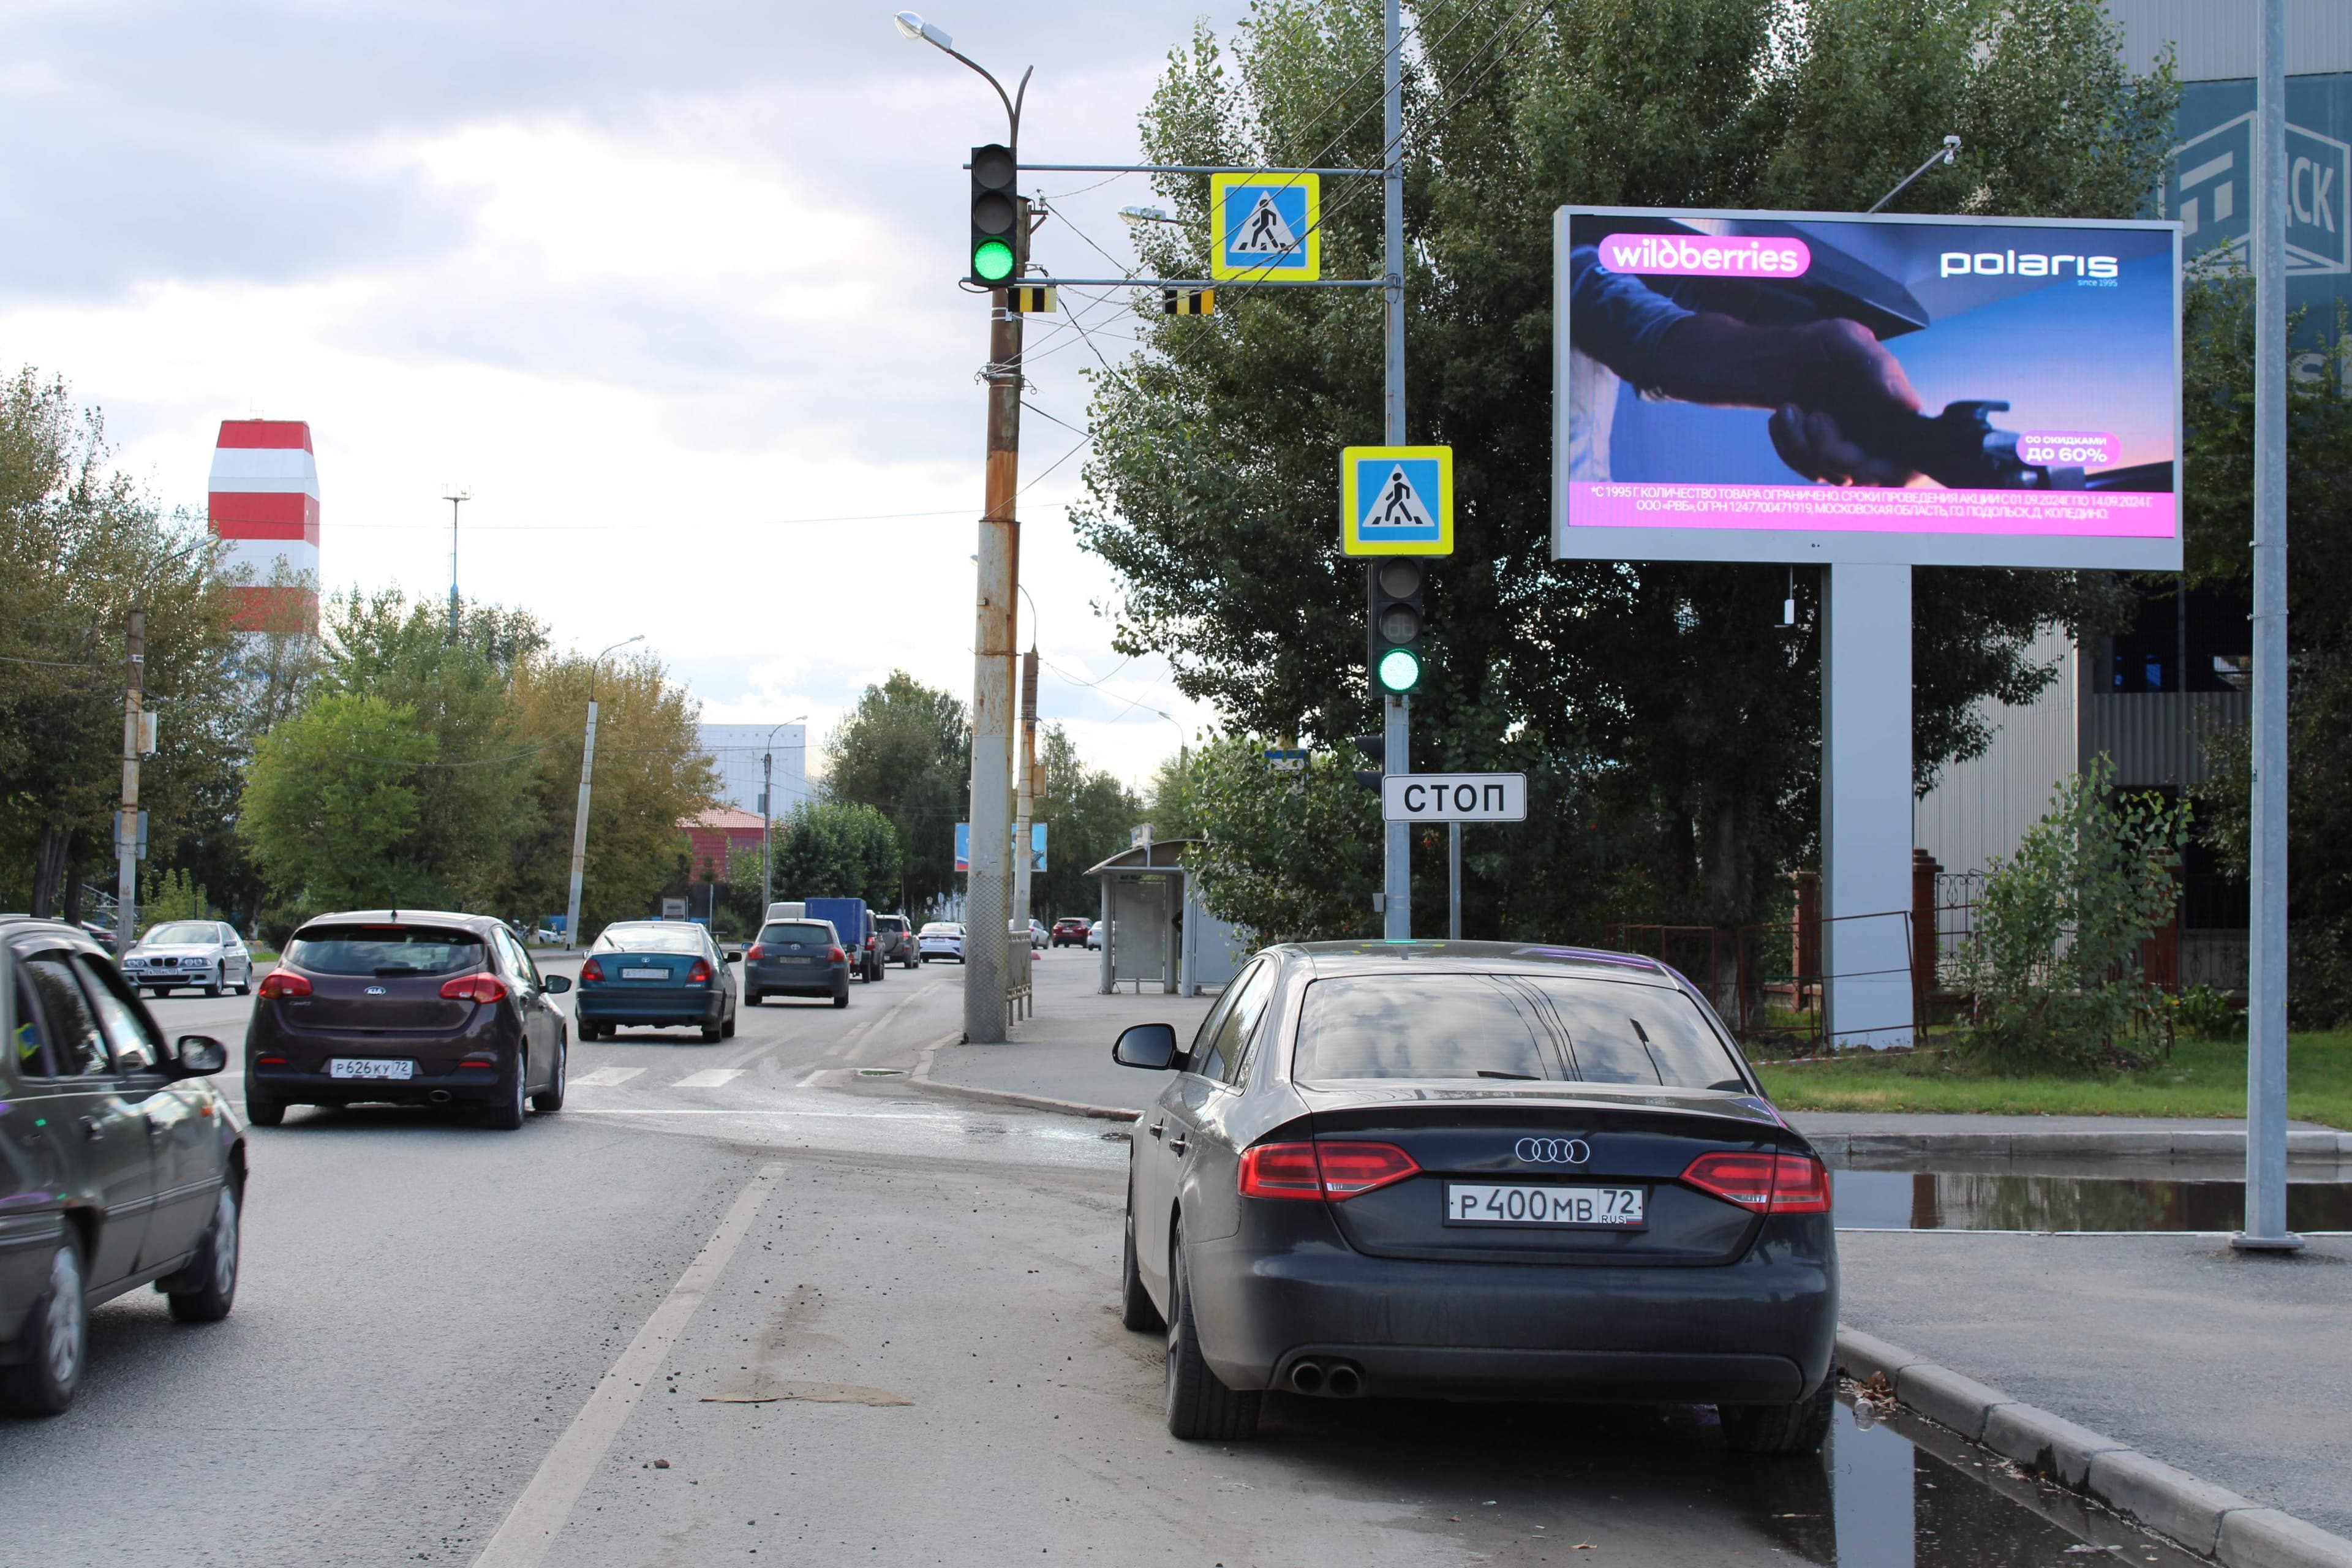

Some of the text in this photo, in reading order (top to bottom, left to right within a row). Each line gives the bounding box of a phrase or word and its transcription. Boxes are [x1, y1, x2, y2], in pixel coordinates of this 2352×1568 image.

[2285, 152, 2335, 233] СК
[1612, 238, 1798, 272] wildberries
[1940, 249, 2118, 278] polaris
[2099, 279, 2117, 287] 1995
[2059, 447, 2108, 462] 60%
[1641, 486, 1717, 500] КОЛИЧЕСТВО
[1718, 488, 1762, 500] ТОВАРА
[1841, 491, 1880, 502] СРОКИ
[1882, 491, 1958, 504] ПРОВЕДЕНИЯ
[1959, 492, 2000, 505] АКЦИИ
[1636, 499, 1662, 511] ООО
[1697, 500, 1728, 512] ОГРН
[1815, 502, 1893, 516] МОСКОВСКАЯ
[1404, 784, 1504, 812] СТОП
[336, 1061, 409, 1075] Р626КУ 72
[1461, 1189, 1634, 1221] Р400МВ 72
[1602, 1215, 1625, 1224] RUS
